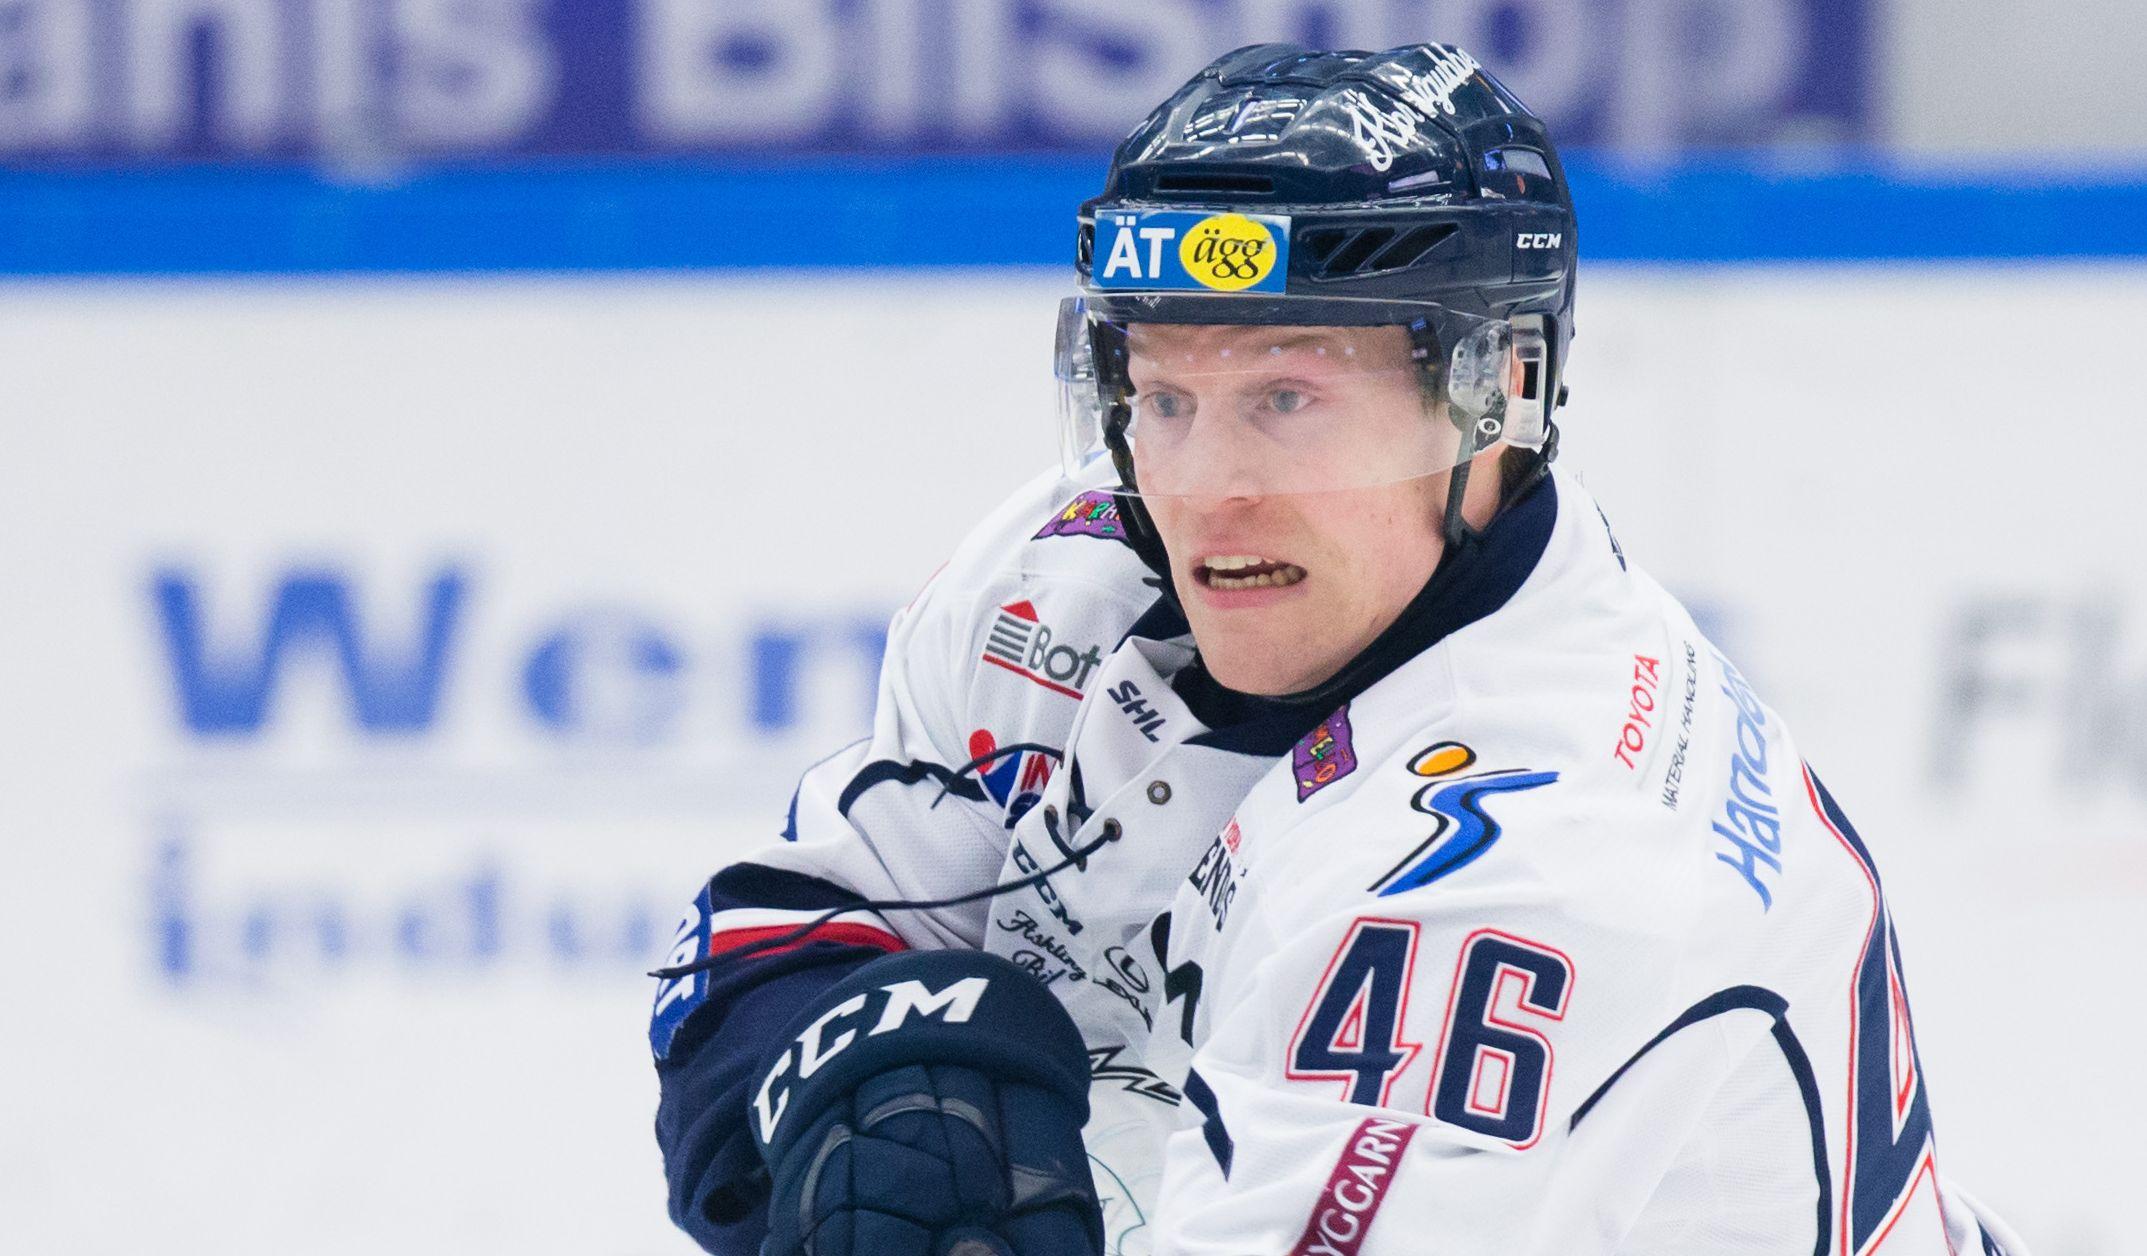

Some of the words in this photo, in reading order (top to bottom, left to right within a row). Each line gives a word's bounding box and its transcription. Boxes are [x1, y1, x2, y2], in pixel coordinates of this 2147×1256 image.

[1102, 215, 1175, 279] ÄT
[1193, 227, 1267, 280] ägg
[1516, 232, 1562, 249] CCM
[1106, 679, 1172, 743] SHL
[1613, 653, 1661, 770] TOYOTA
[1661, 735, 1690, 812] MATERIAL
[1012, 838, 1084, 936] CCM
[752, 976, 990, 1145] CCM
[1286, 916, 1575, 1151] 46
